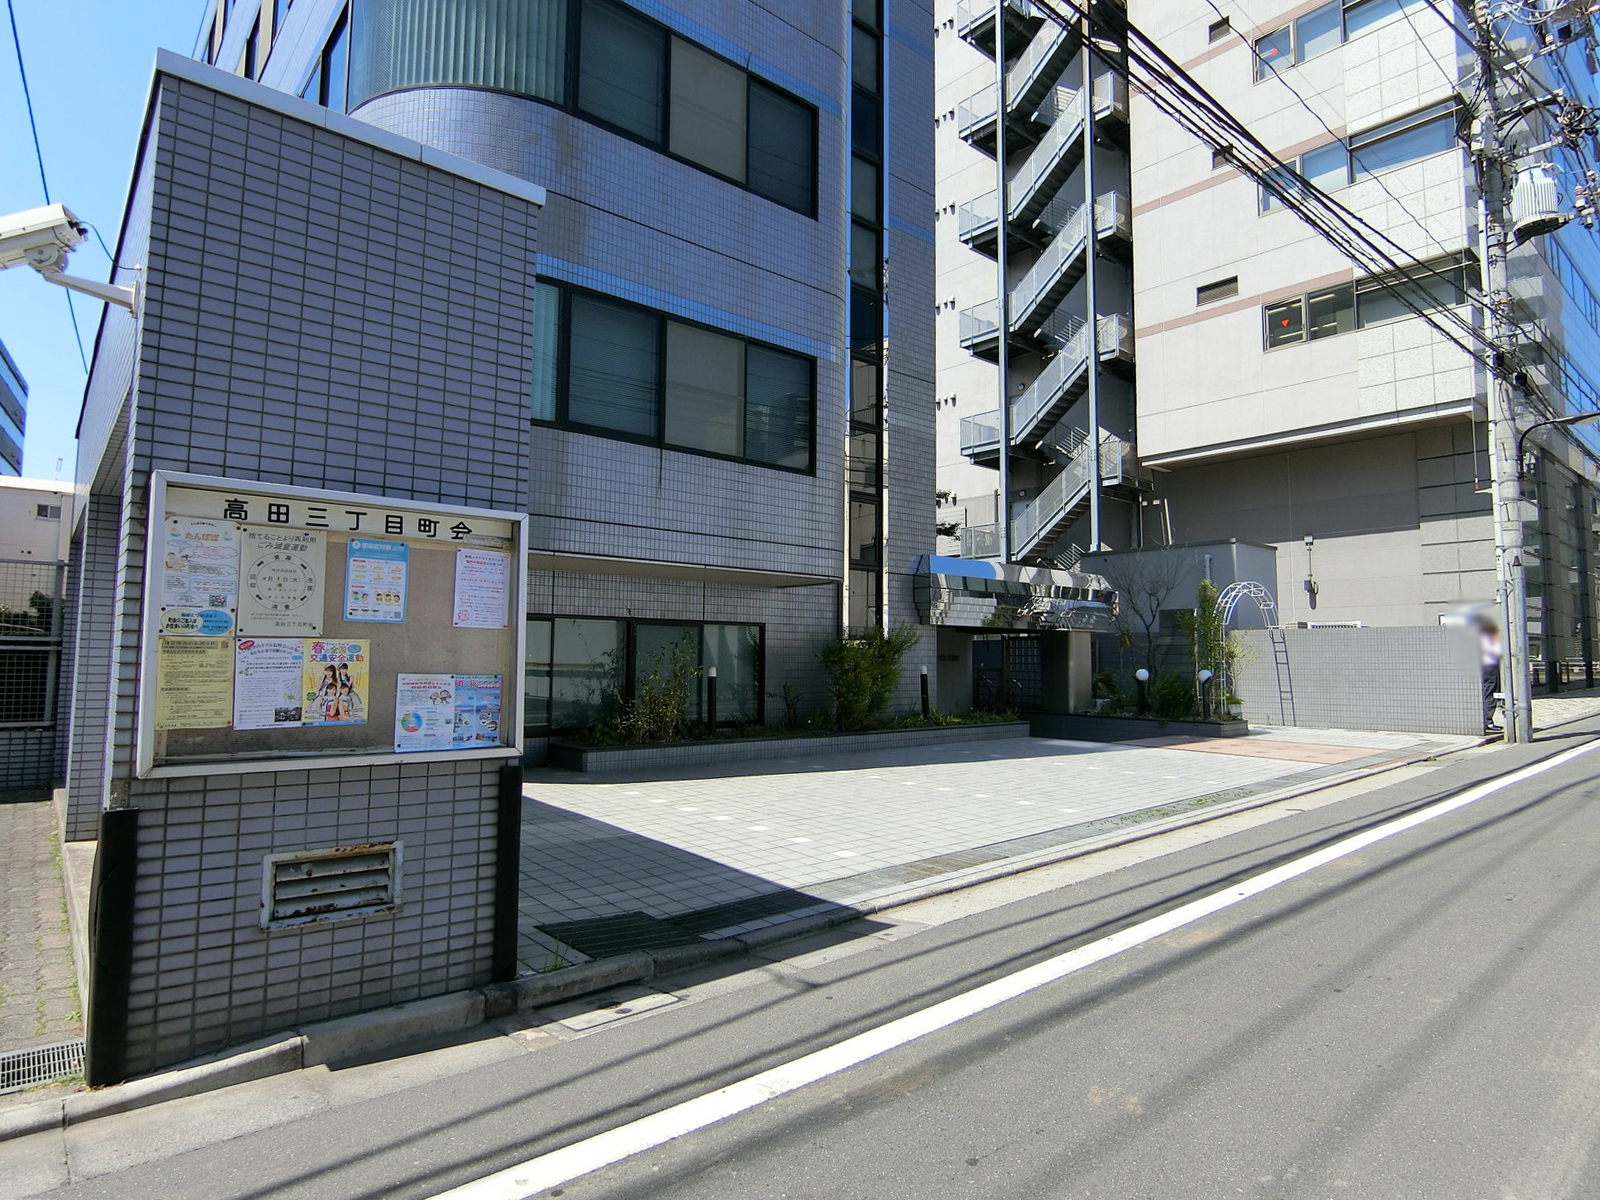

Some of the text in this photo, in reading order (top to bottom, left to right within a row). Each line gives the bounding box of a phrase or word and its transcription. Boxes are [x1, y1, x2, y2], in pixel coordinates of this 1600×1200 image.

[223, 498, 473, 540] 高田三丁目町会
[248, 532, 317, 544] 捨てることより再利用
[257, 541, 308, 552] ごみ減量運動
[312, 641, 347, 654] 春の全国
[309, 653, 365, 663] 交通安全運動
